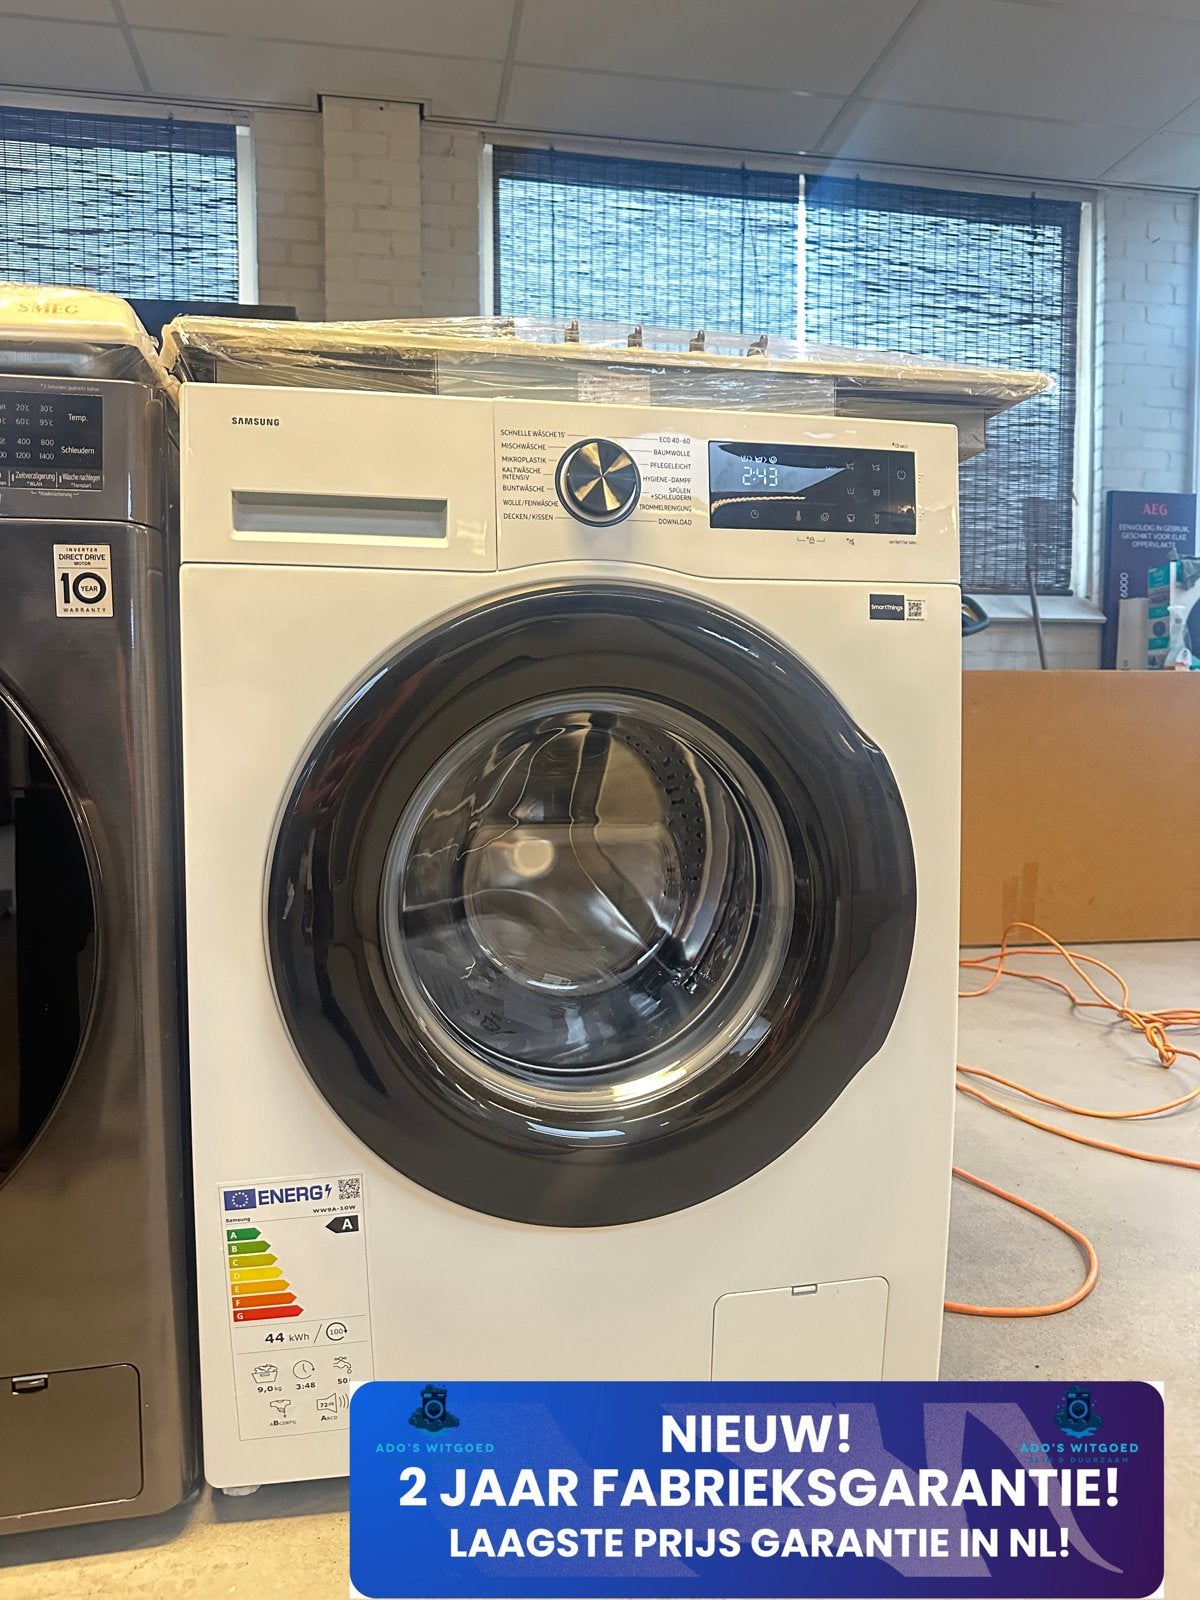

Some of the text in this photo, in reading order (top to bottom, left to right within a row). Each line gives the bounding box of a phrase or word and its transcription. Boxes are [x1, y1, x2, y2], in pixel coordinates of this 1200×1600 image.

[68, 414, 88, 422] Temp.
[232, 417, 280, 426] SAMSUNG
[501, 442, 546, 450] MISCHWÄSCHE
[61, 446, 95, 455] Schleudern
[654, 449, 691, 457] BAUMWOLLE
[502, 466, 541, 474] KALTWÄSCHE
[742, 466, 778, 487] 2:43
[503, 484, 545, 492] BUNTWÄSCHE
[669, 486, 691, 494] SPÜLEN
[640, 504, 692, 512] TROMMELREINIGUNG
[1142, 504, 1168, 515] AEG
[60, 572, 106, 604] 10
[871, 604, 903, 612] SmartThings
[258, 1185, 323, 1206] ENERG
[313, 1205, 356, 1213] WW9A-10W
[342, 1219, 353, 1230] A
[230, 1231, 237, 1239] A
[265, 1333, 285, 1343] 44
[289, 1333, 310, 1342] kWh
[296, 1382, 315, 1390] 3:48
